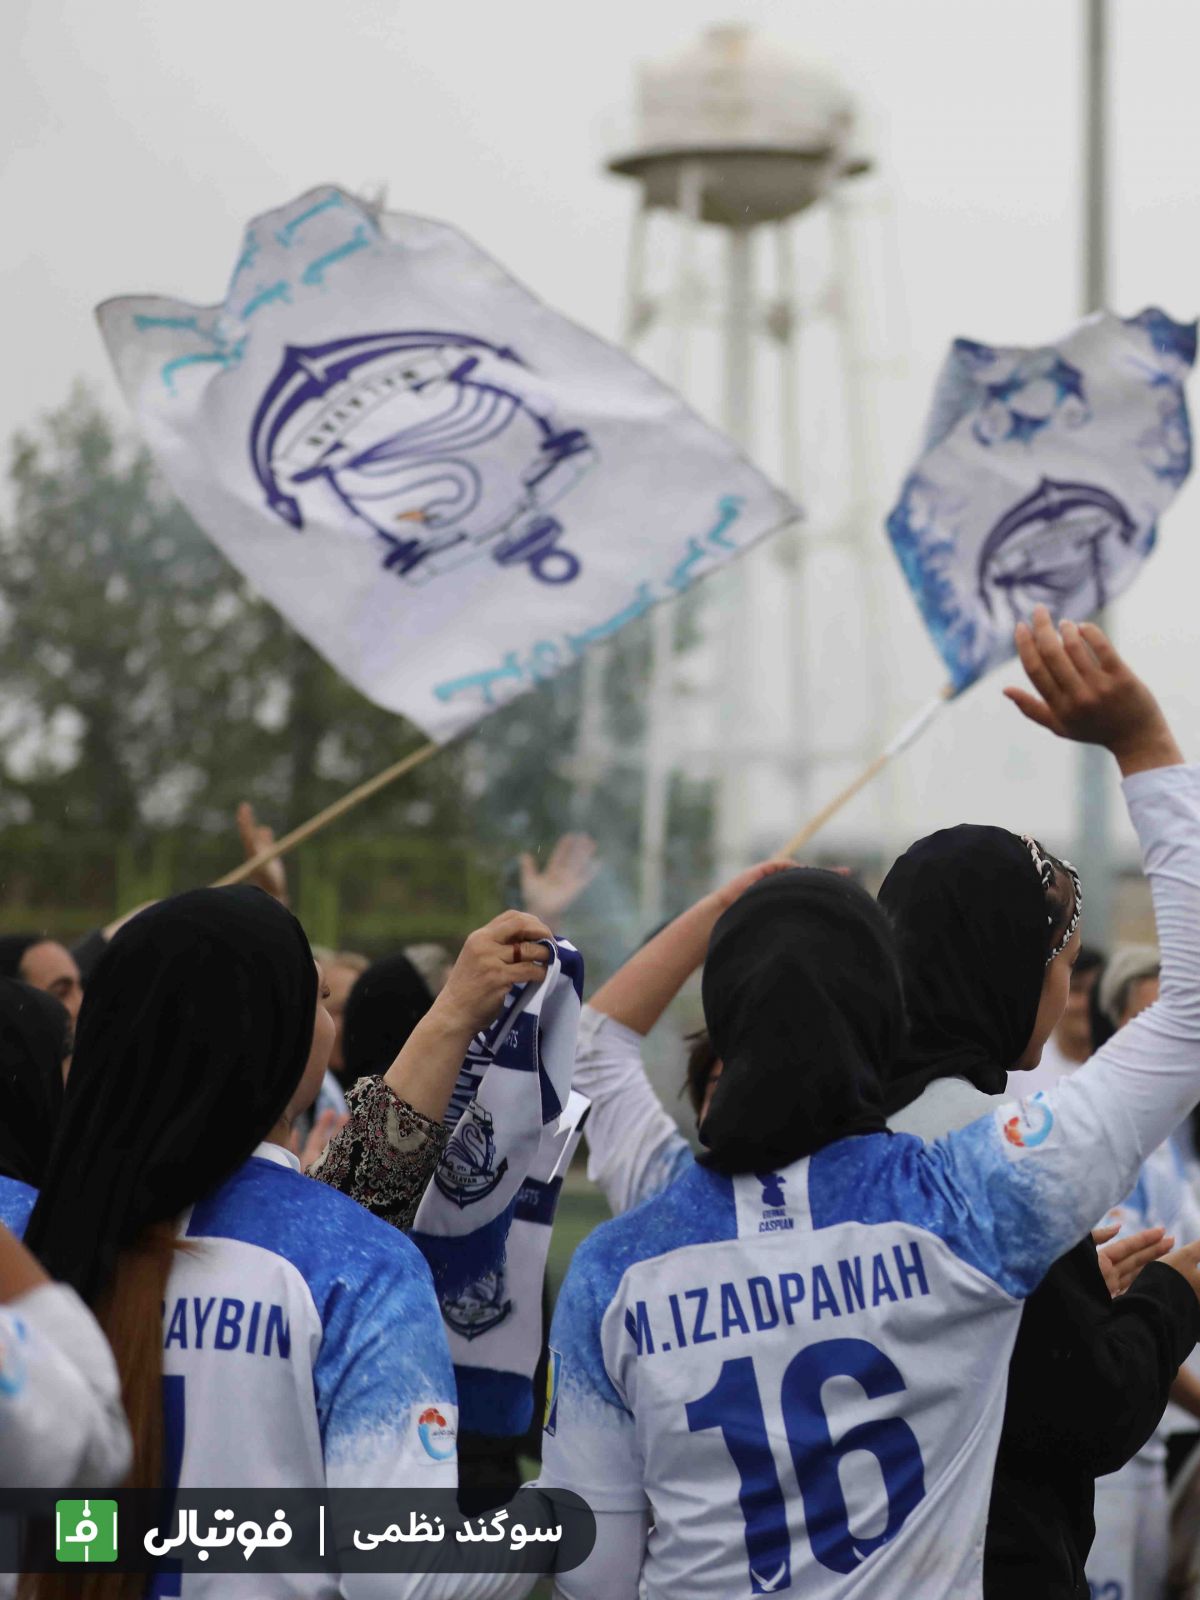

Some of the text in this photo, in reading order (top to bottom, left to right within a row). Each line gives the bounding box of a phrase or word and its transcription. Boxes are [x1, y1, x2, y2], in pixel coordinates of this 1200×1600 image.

[759, 1218, 795, 1233] CASPIAN
[160, 1296, 292, 1360] AYBIN
[624, 1241, 931, 1356] M.IZADPANAH
[684, 1336, 928, 1595] 16
